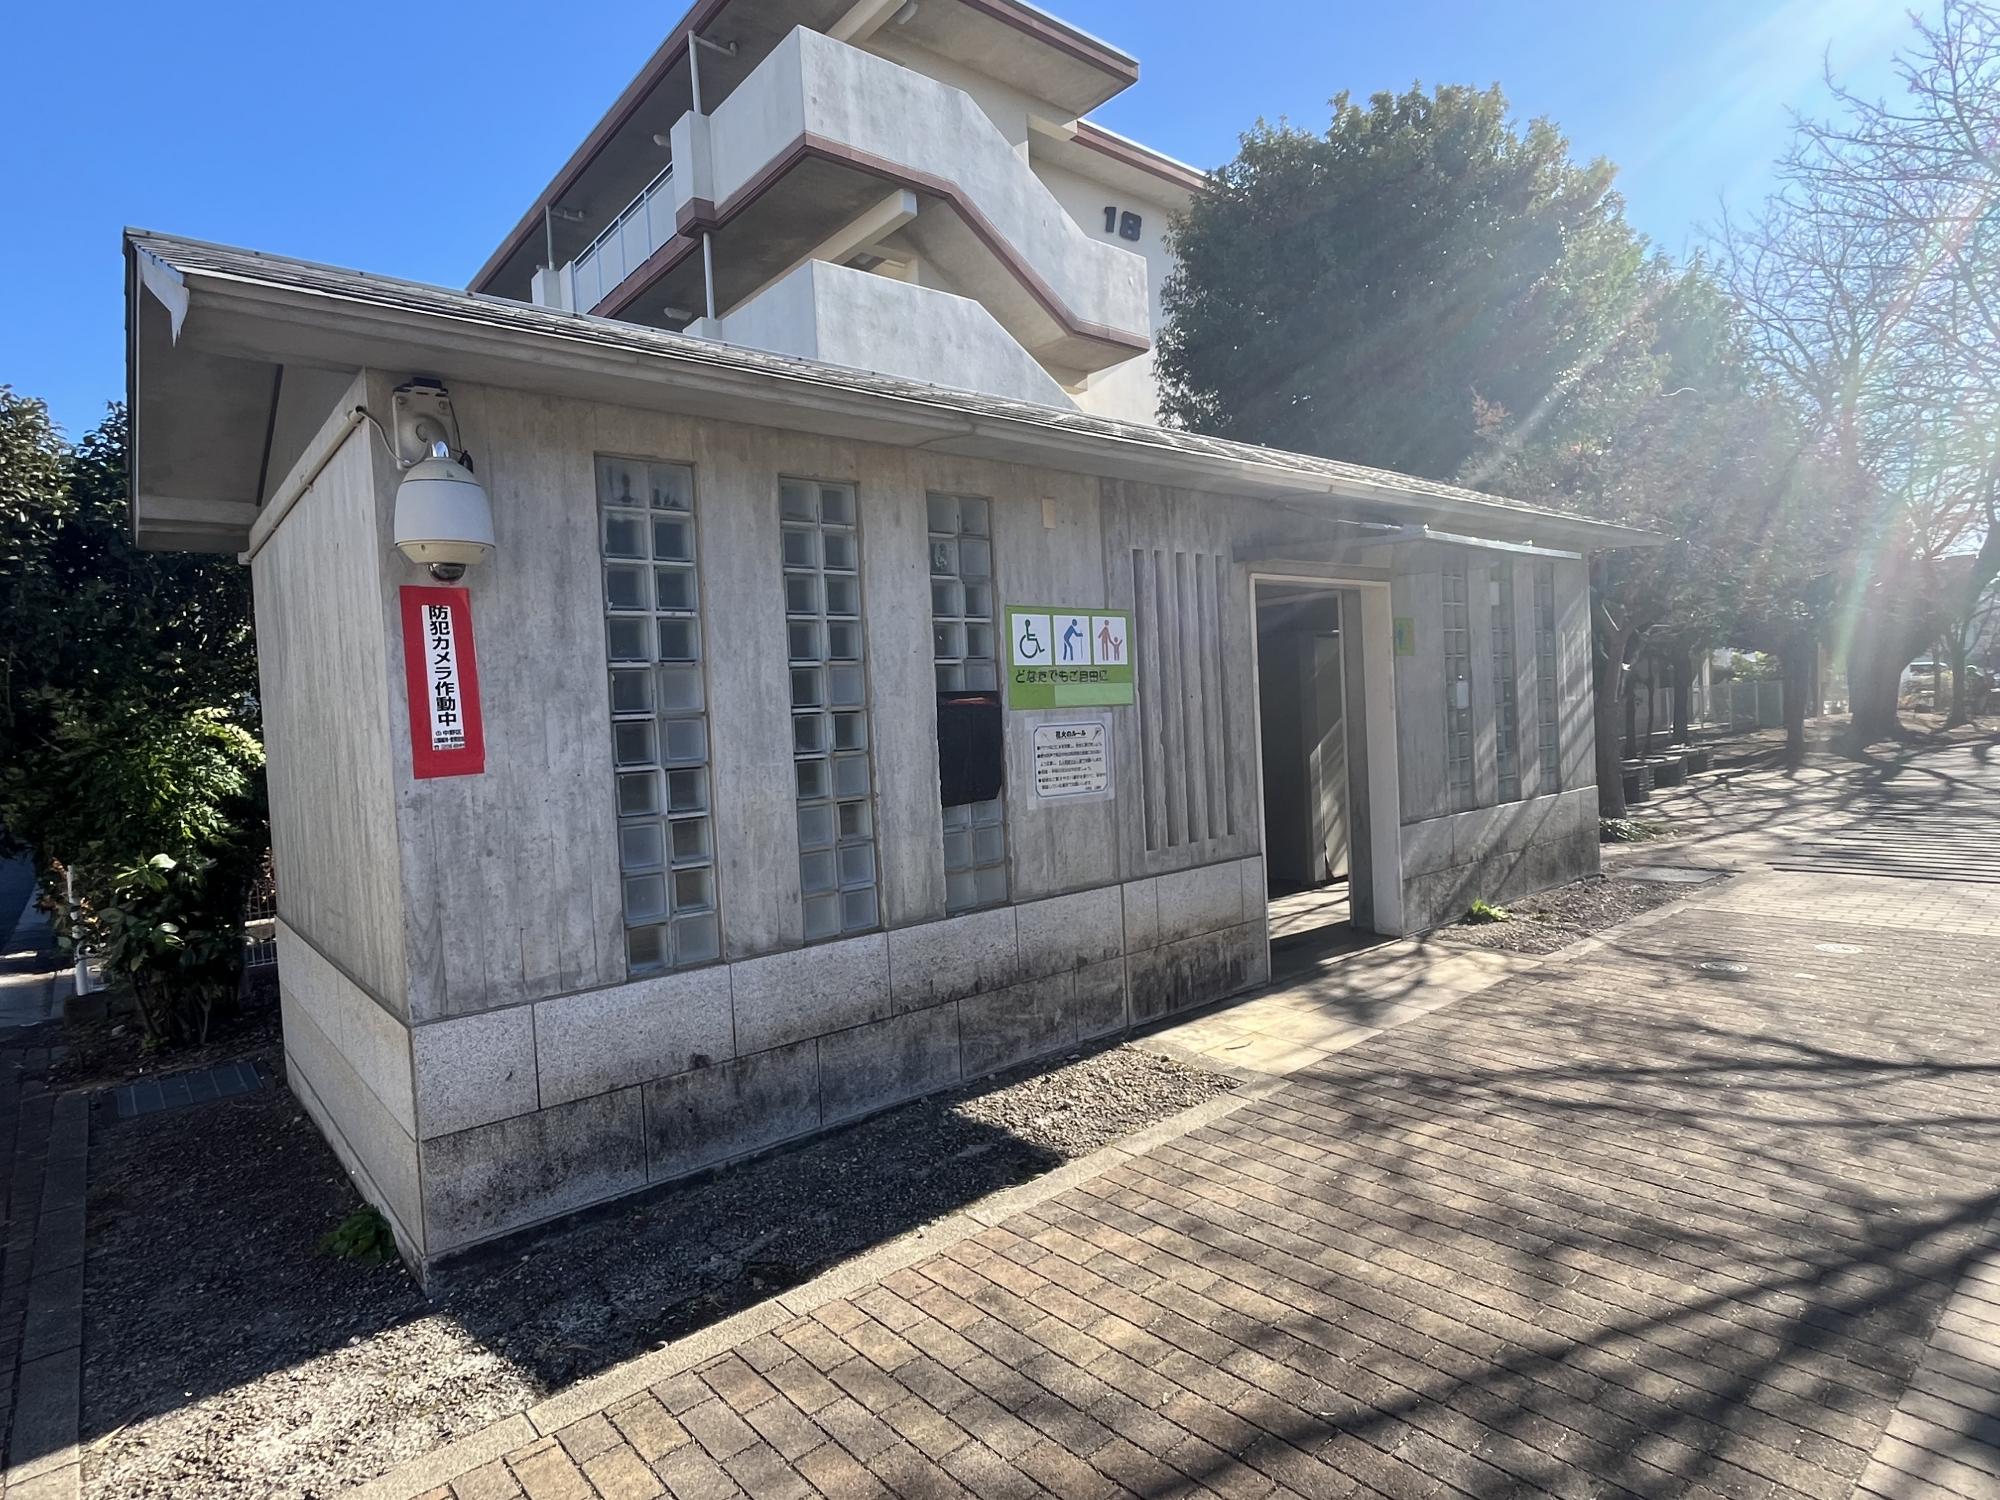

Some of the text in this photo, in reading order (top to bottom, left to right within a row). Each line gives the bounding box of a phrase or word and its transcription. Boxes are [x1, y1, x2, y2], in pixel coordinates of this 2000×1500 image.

[1104, 206, 1142, 242] 18
[428, 605, 457, 727] 防犯カメラ作動中
[1015, 669, 1109, 684] どなたでもご自由に
